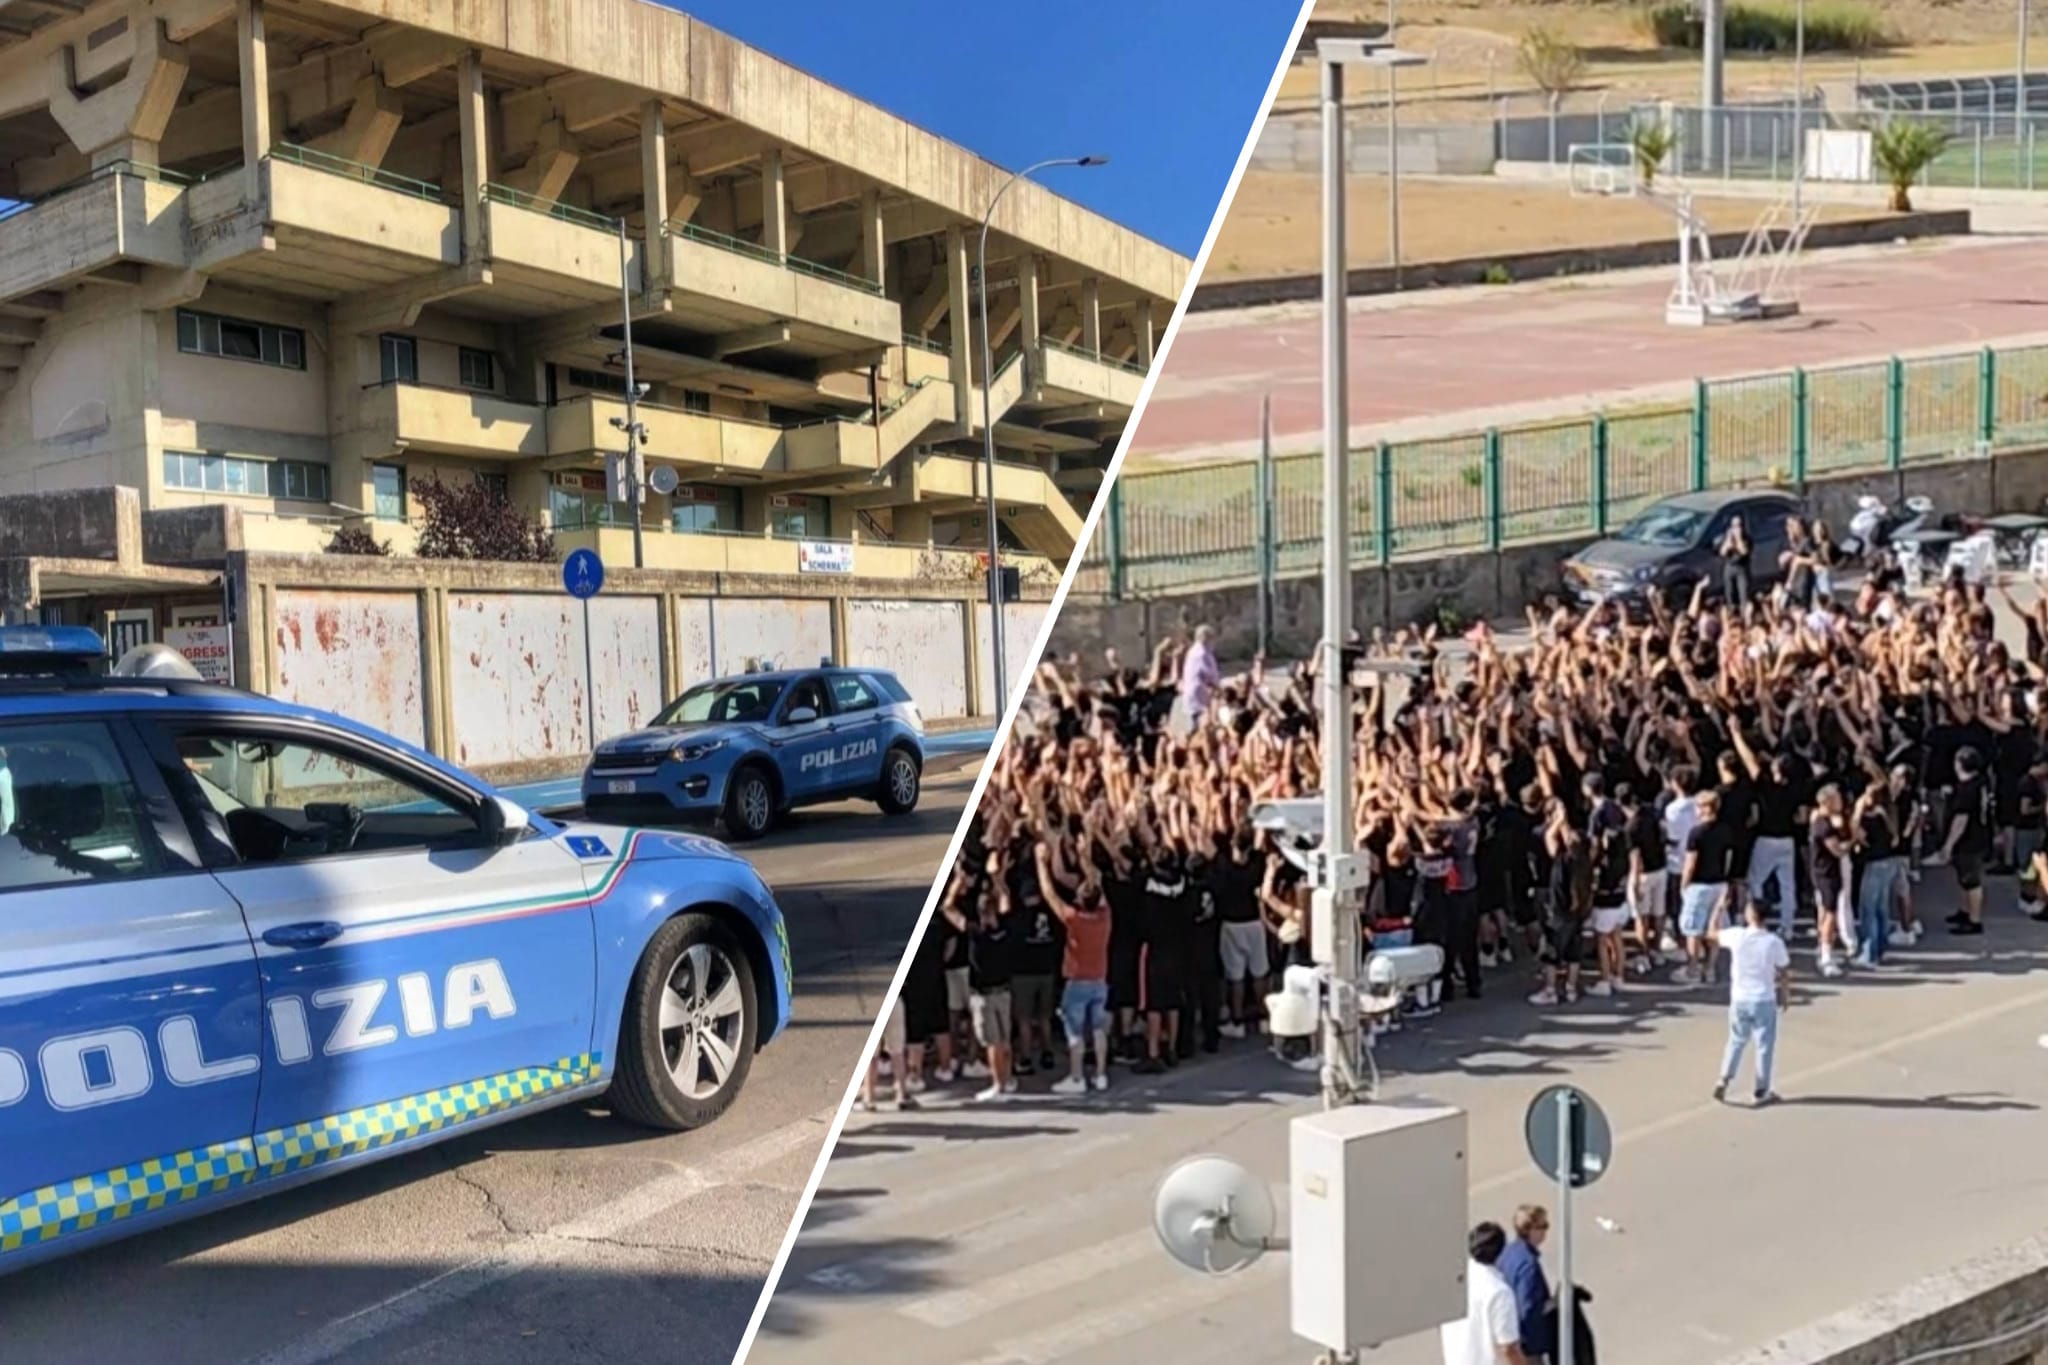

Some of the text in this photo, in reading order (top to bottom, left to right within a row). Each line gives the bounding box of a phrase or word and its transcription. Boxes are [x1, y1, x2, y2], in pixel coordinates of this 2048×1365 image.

[814, 543, 832, 554] SALA
[178, 645, 226, 660] GRESS
[801, 737, 877, 772] POLIZIA
[0, 957, 517, 1112] OLIZIA
